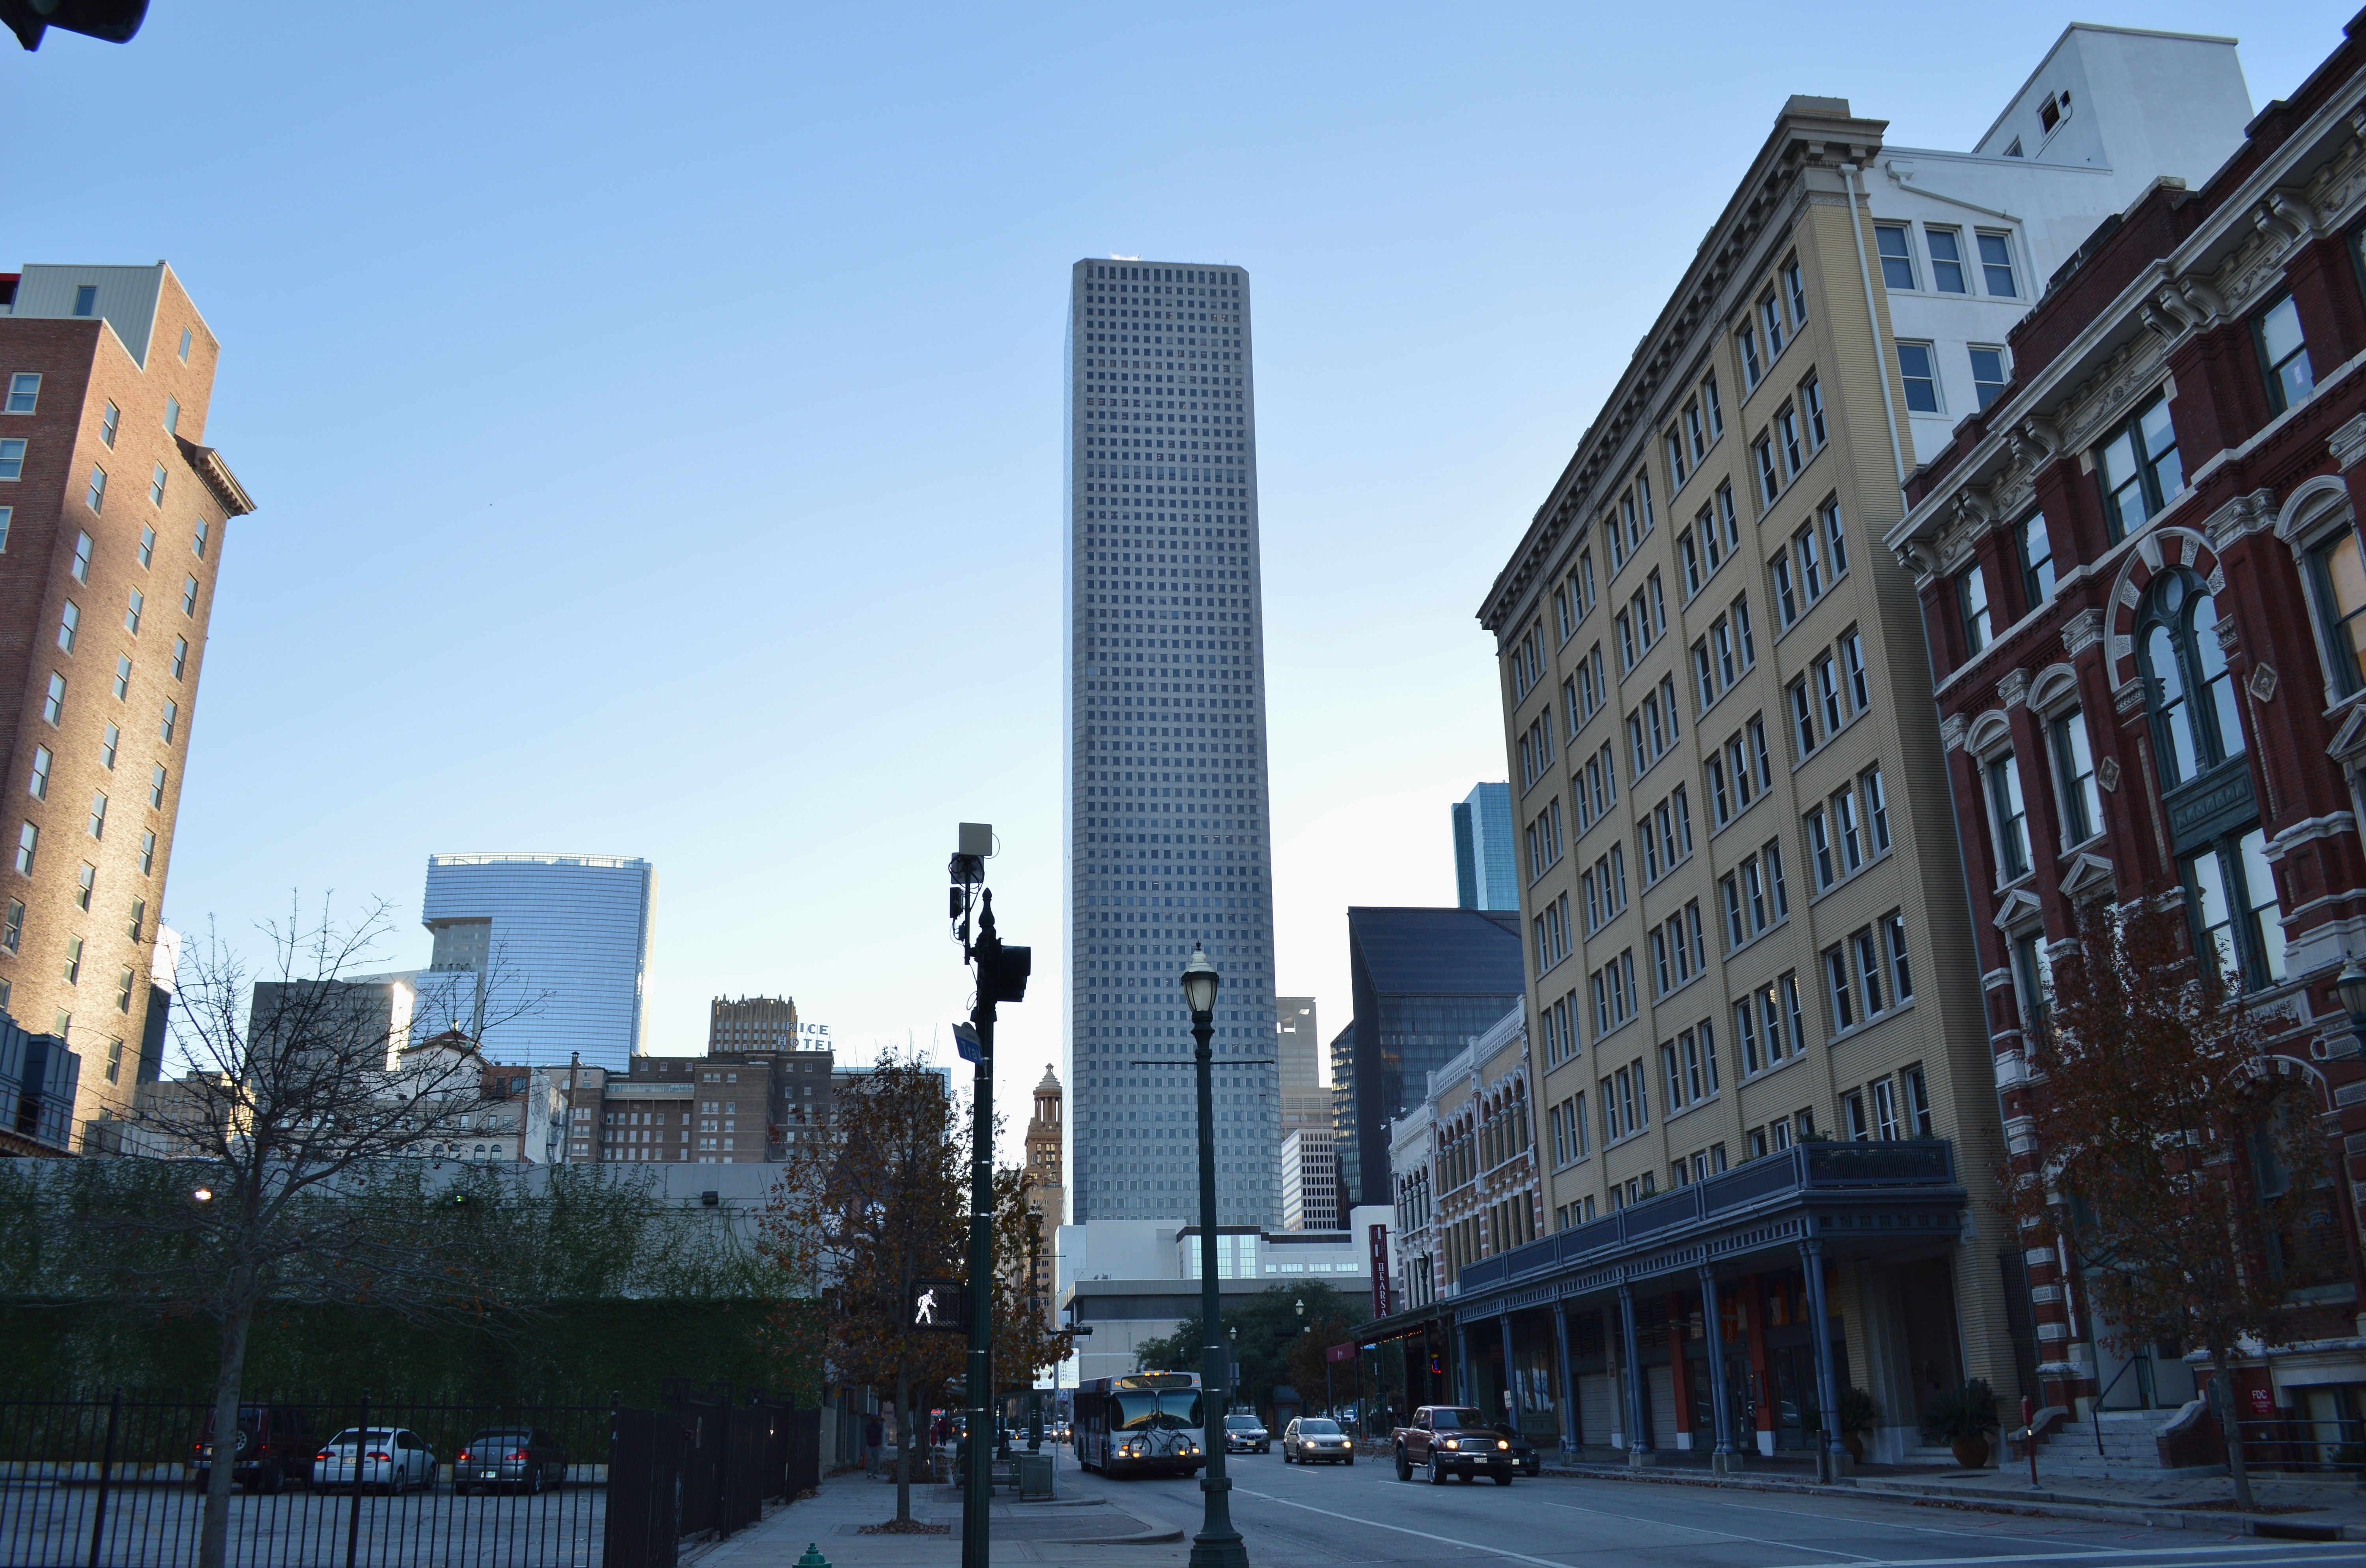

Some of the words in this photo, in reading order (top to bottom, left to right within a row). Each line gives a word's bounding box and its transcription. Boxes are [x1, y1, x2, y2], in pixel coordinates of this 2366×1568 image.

[786, 1021, 828, 1035] RICE
[778, 1036, 836, 1051] HOTEL
[961, 1041, 981, 1062] Trav
[1378, 1263, 1387, 1318] HEARSA
[2252, 1389, 2267, 1400] FDC
